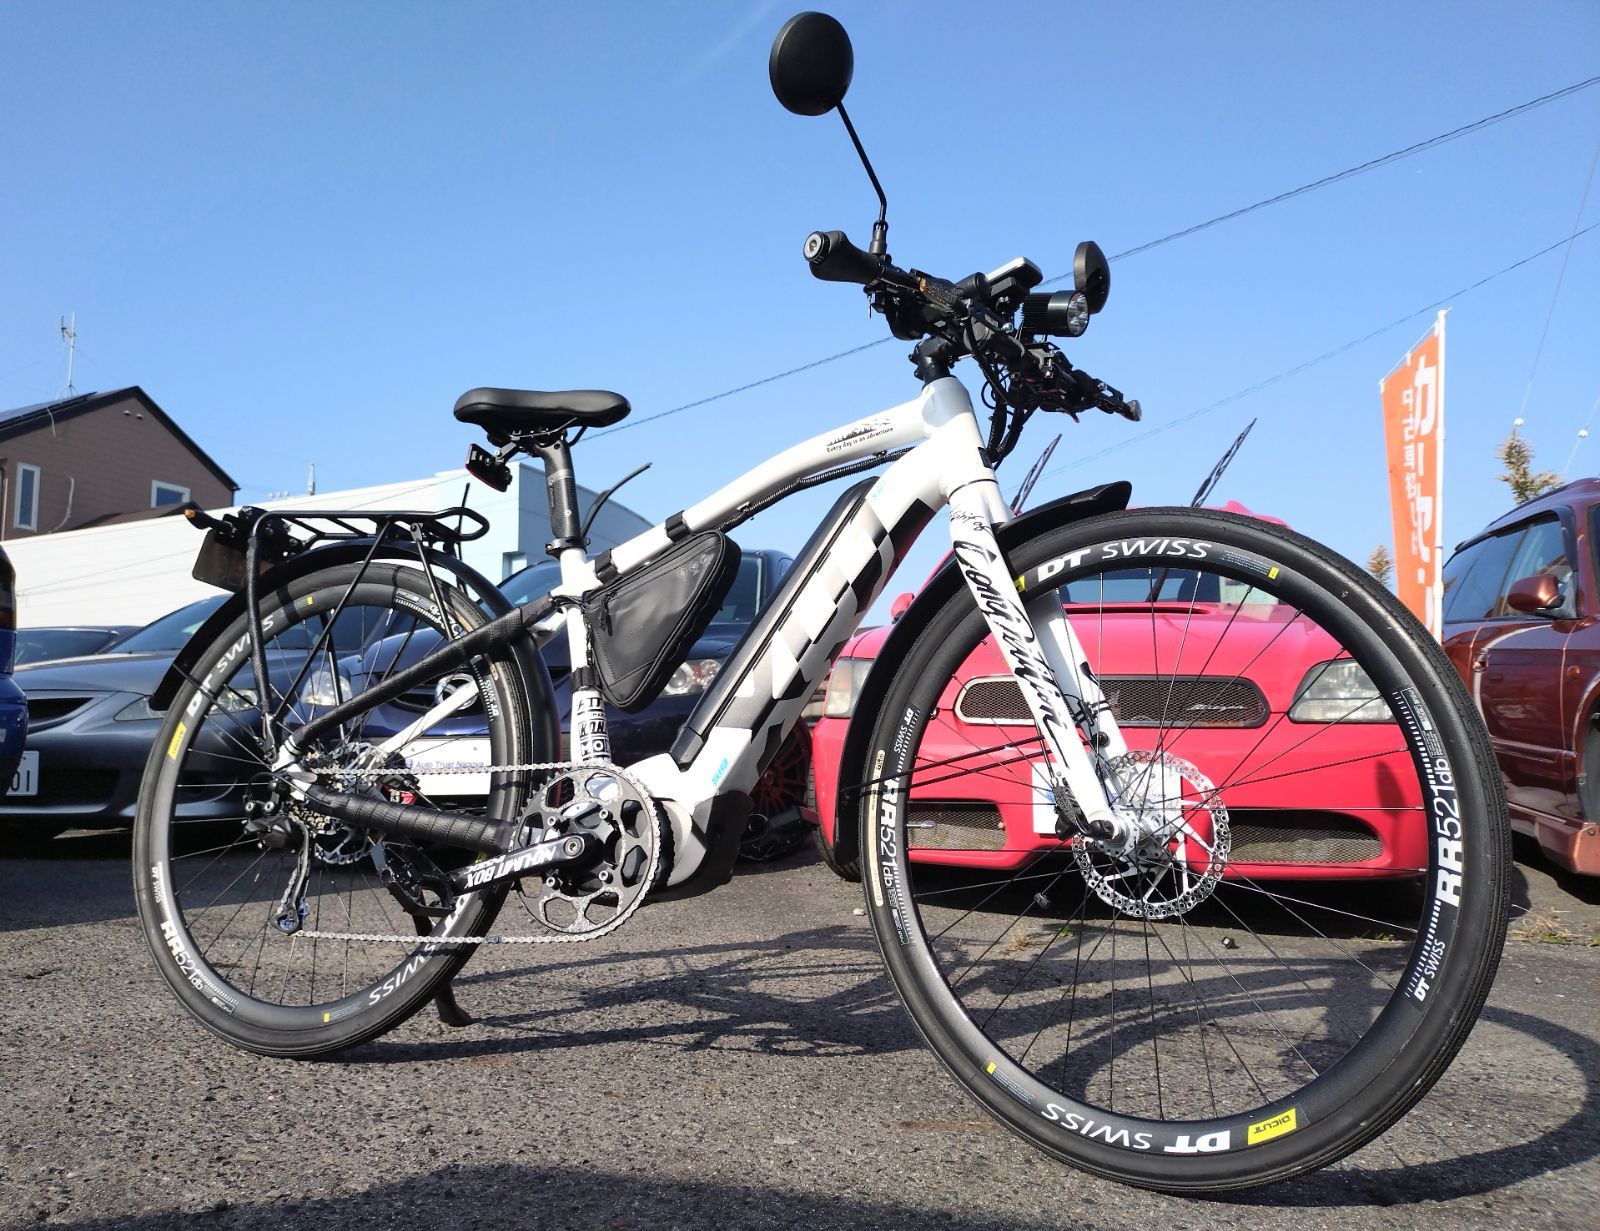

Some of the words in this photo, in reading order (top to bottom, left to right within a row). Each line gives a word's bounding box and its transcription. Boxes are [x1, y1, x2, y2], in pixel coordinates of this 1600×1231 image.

[1037, 549, 1091, 582] DT
[1101, 539, 1213, 560] SWISS
[186, 674, 213, 717] DT
[217, 614, 274, 674] SWIS
[485, 679, 496, 702] SWISS
[490, 702, 499, 717] DT
[894, 724, 908, 753] SWISS
[903, 708, 914, 727] DT
[880, 776, 898, 887] RR521db
[1433, 757, 1465, 907] RR521db
[464, 866, 496, 889] BOX
[160, 918, 204, 992] RR521db
[369, 942, 436, 1006] SWISS
[1414, 977, 1430, 1001] DT
[1426, 938, 1446, 979] SWISS
[1041, 1103, 1153, 1150] SWISS
[1164, 1130, 1230, 1153] DT
